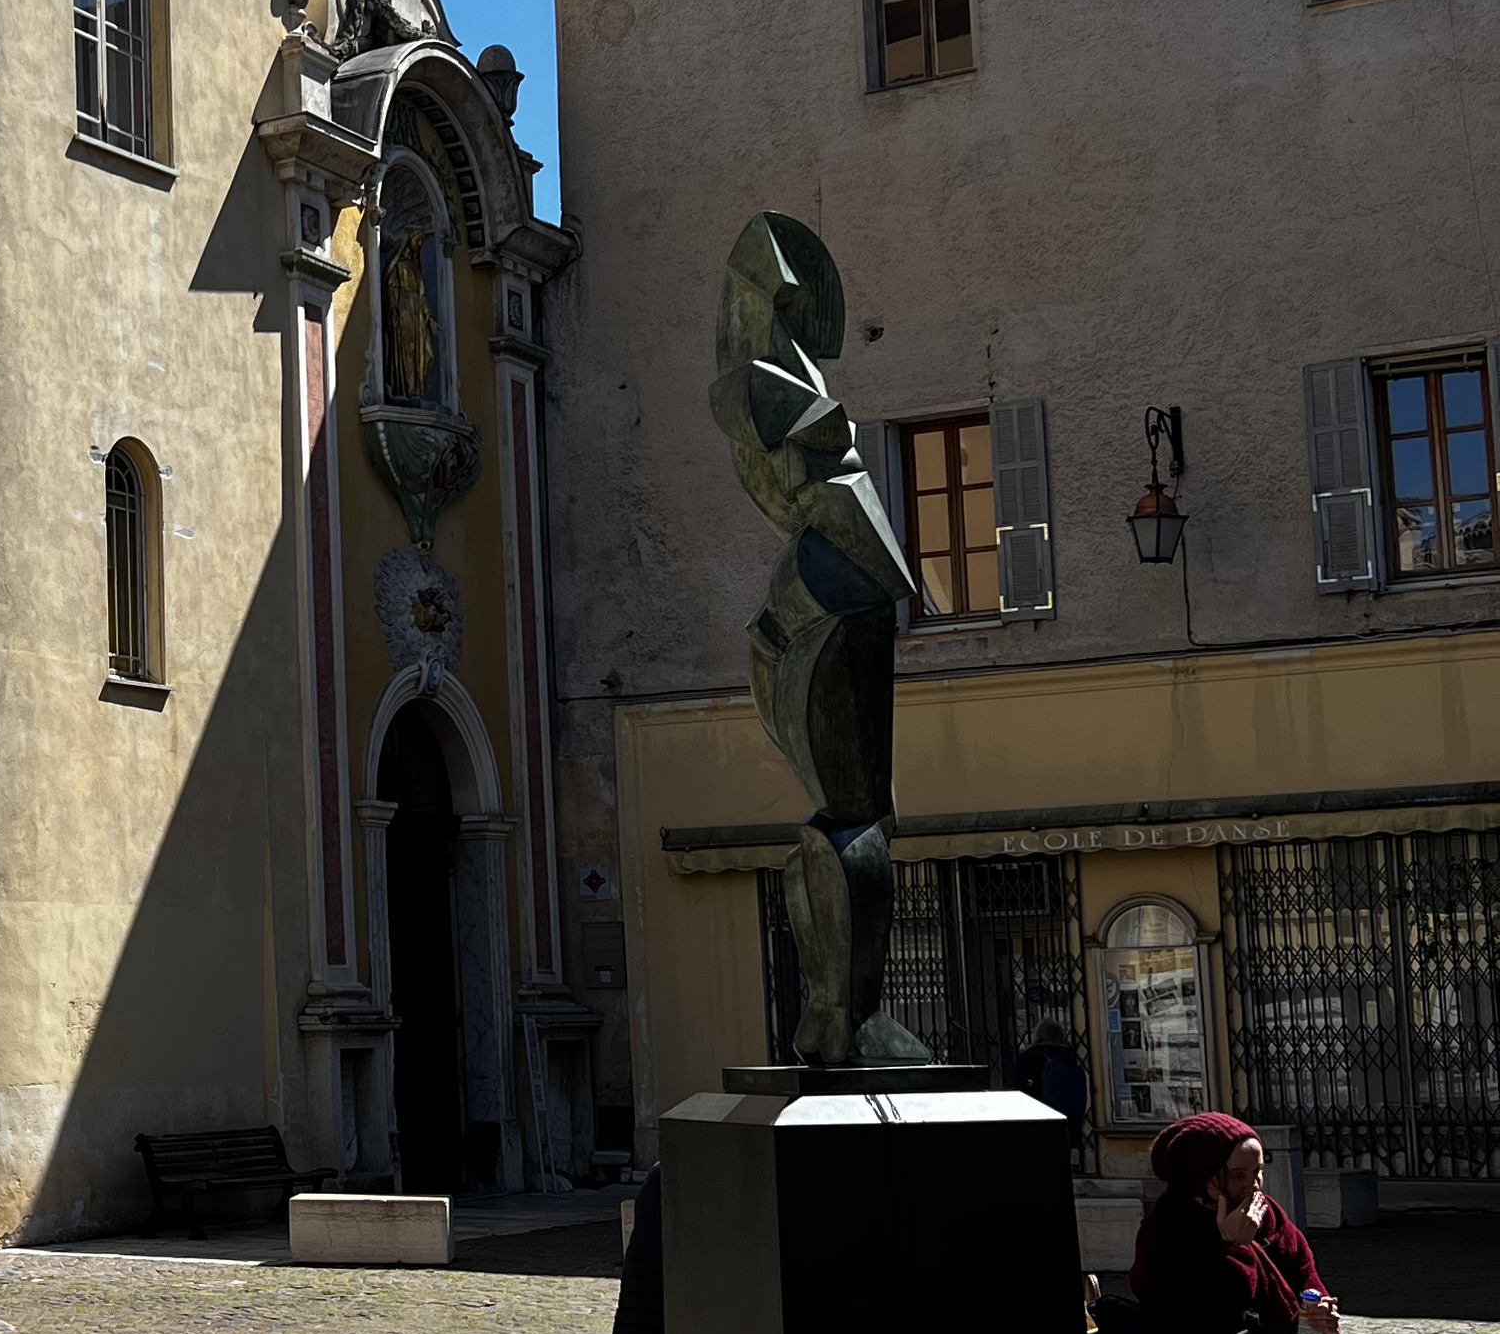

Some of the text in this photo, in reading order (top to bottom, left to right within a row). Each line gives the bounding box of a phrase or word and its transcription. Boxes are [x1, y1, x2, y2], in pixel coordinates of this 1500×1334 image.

[1002, 819, 1291, 853] ECOLE DE DANSE
